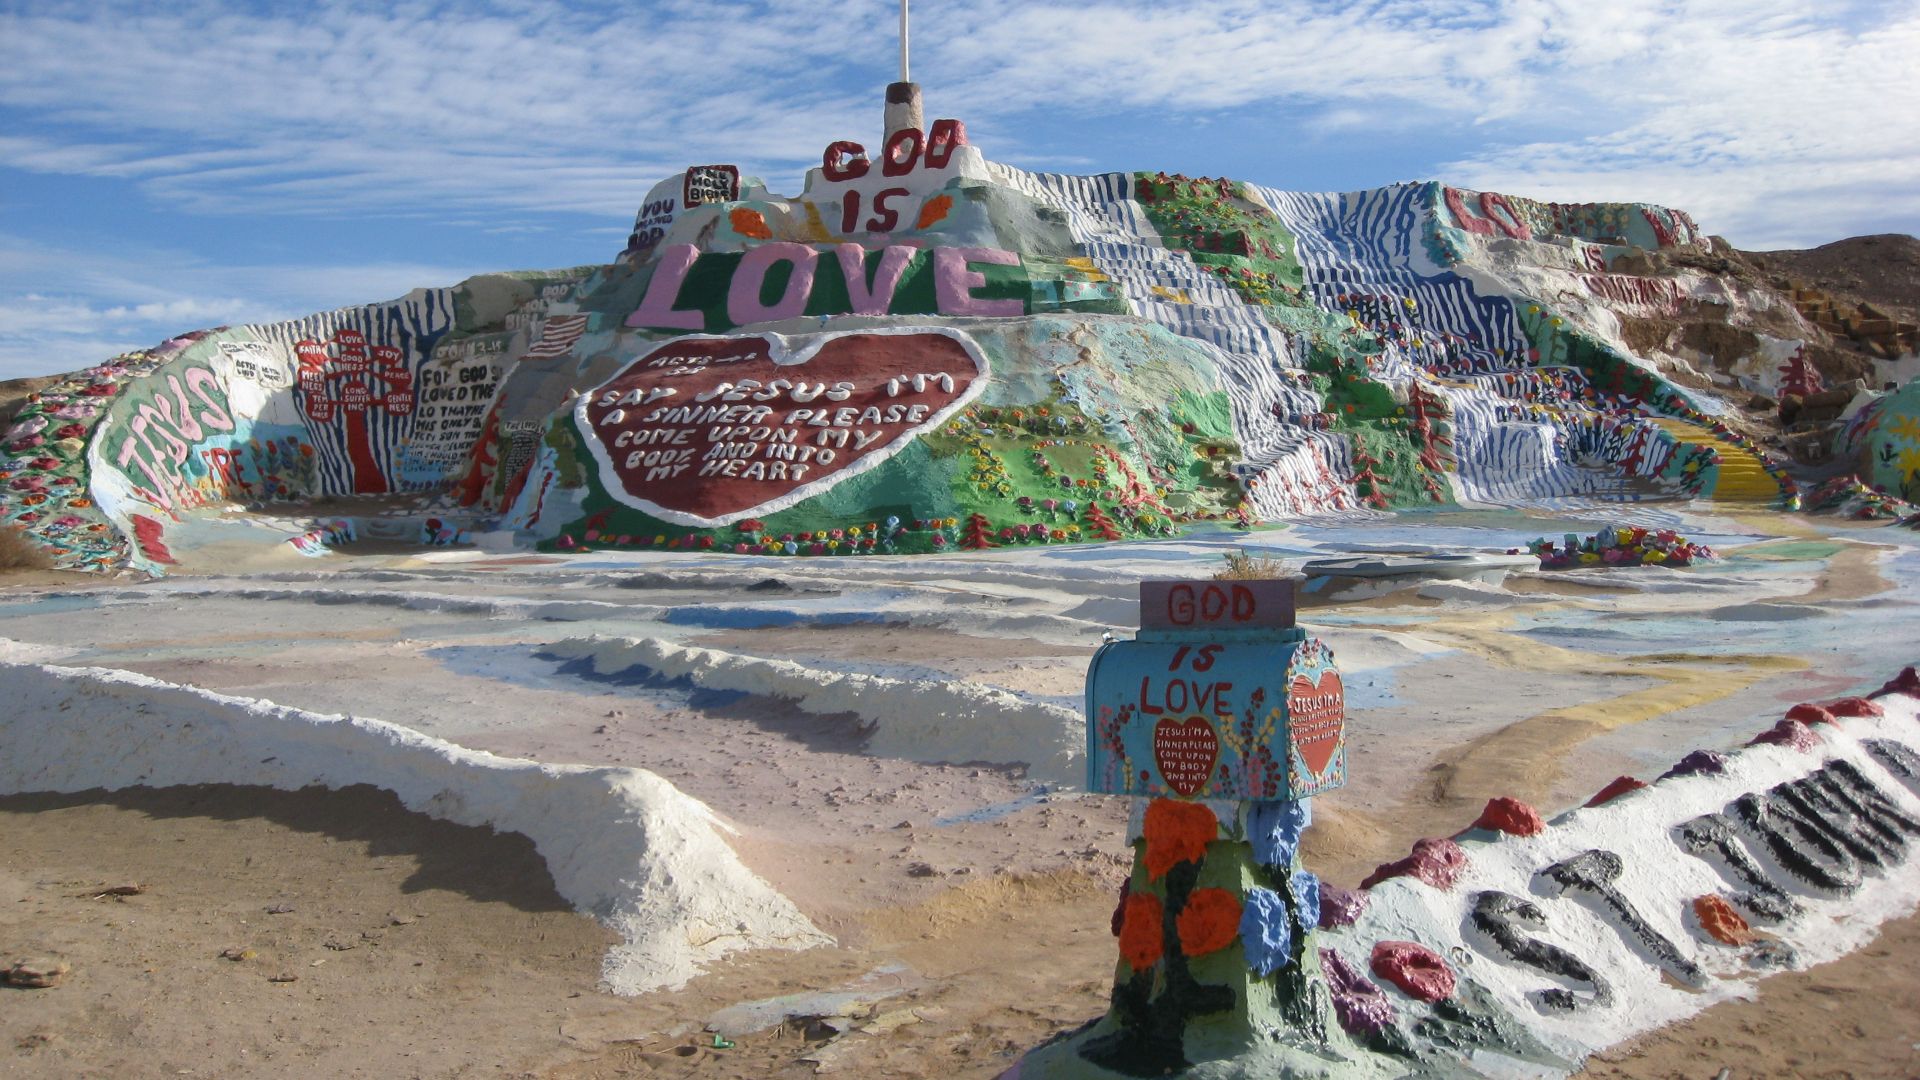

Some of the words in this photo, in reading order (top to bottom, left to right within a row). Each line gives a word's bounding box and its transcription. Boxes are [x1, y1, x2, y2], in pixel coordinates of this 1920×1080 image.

[822, 119, 967, 182] GOD
[692, 176, 729, 189] HOLY
[690, 188, 730, 201] BIBLE
[641, 199, 675, 219] YOU
[841, 188, 911, 233] IS
[625, 243, 1024, 330] LOVE
[340, 335, 363, 344] LOVE
[298, 345, 321, 355] FAITH
[377, 350, 401, 361] JOY
[459, 365, 487, 383] GOD
[421, 386, 468, 403] LOVED
[597, 388, 678, 407] SAY
[694, 378, 856, 403] JESUS
[887, 371, 955, 398] I'M
[389, 404, 410, 413] NESS
[600, 409, 626, 426] A
[643, 404, 774, 424] SINNER
[784, 404, 930, 427] PLEASE
[117, 367, 234, 510] JESUS
[615, 428, 697, 447] COME
[708, 426, 798, 443] UPON
[817, 428, 883, 450] MY
[702, 441, 757, 461] AND
[765, 443, 836, 466] INTO
[645, 463, 691, 481] MY
[698, 459, 810, 481] HEART
[1168, 584, 1255, 625] GOD
[1168, 644, 1225, 672] IS
[1140, 677, 1232, 716] LOVE
[1295, 695, 1322, 713] JESUS
[1158, 727, 1186, 737] JESUS
[1188, 726, 1202, 737] I'M
[1203, 728, 1211, 737] A
[1156, 740, 1188, 749] SINNER
[1189, 741, 1216, 750] PLEASE
[1160, 750, 1183, 759] COME
[1186, 752, 1211, 761] UPON
[1163, 760, 1176, 769] MY
[1180, 761, 1207, 771] BODY
[1188, 772, 1207, 781] INTO
